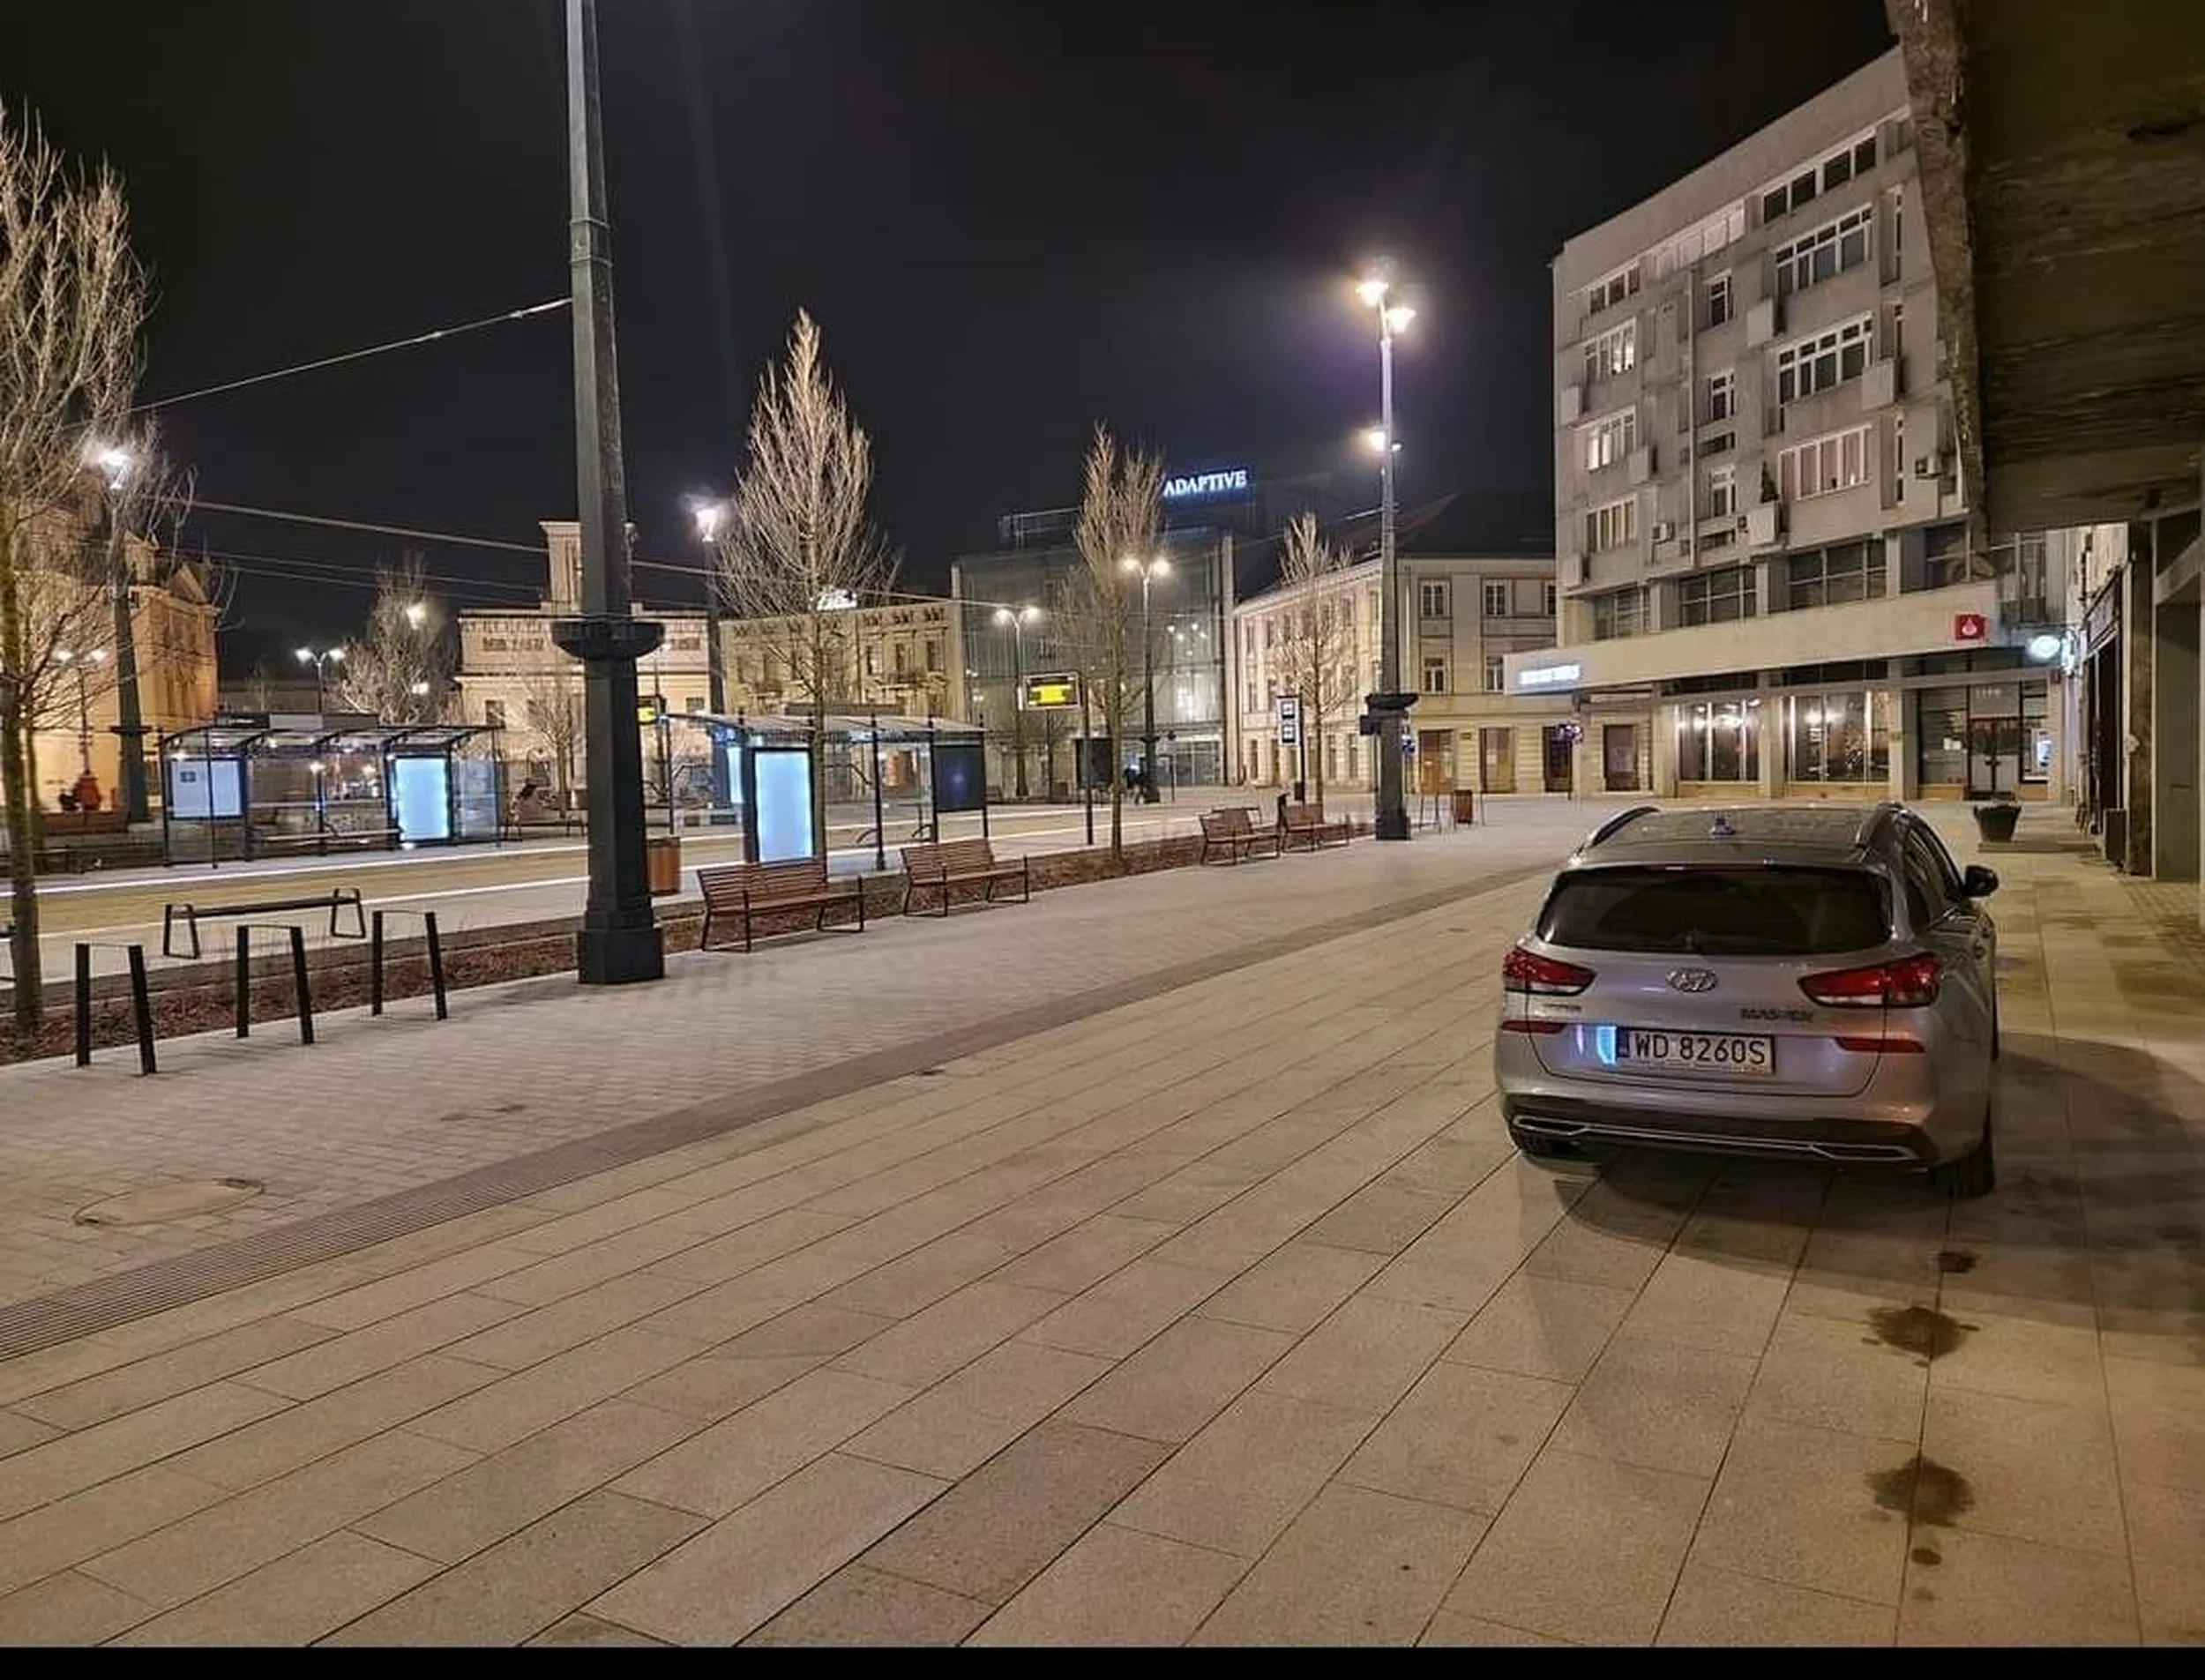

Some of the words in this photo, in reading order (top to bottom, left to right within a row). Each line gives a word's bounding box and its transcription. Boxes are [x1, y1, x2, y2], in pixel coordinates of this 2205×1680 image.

[1162, 469, 1247, 497] ADAPTIVE
[1634, 1034, 1670, 1058] WD
[1678, 1036, 1767, 1065] 8260S
